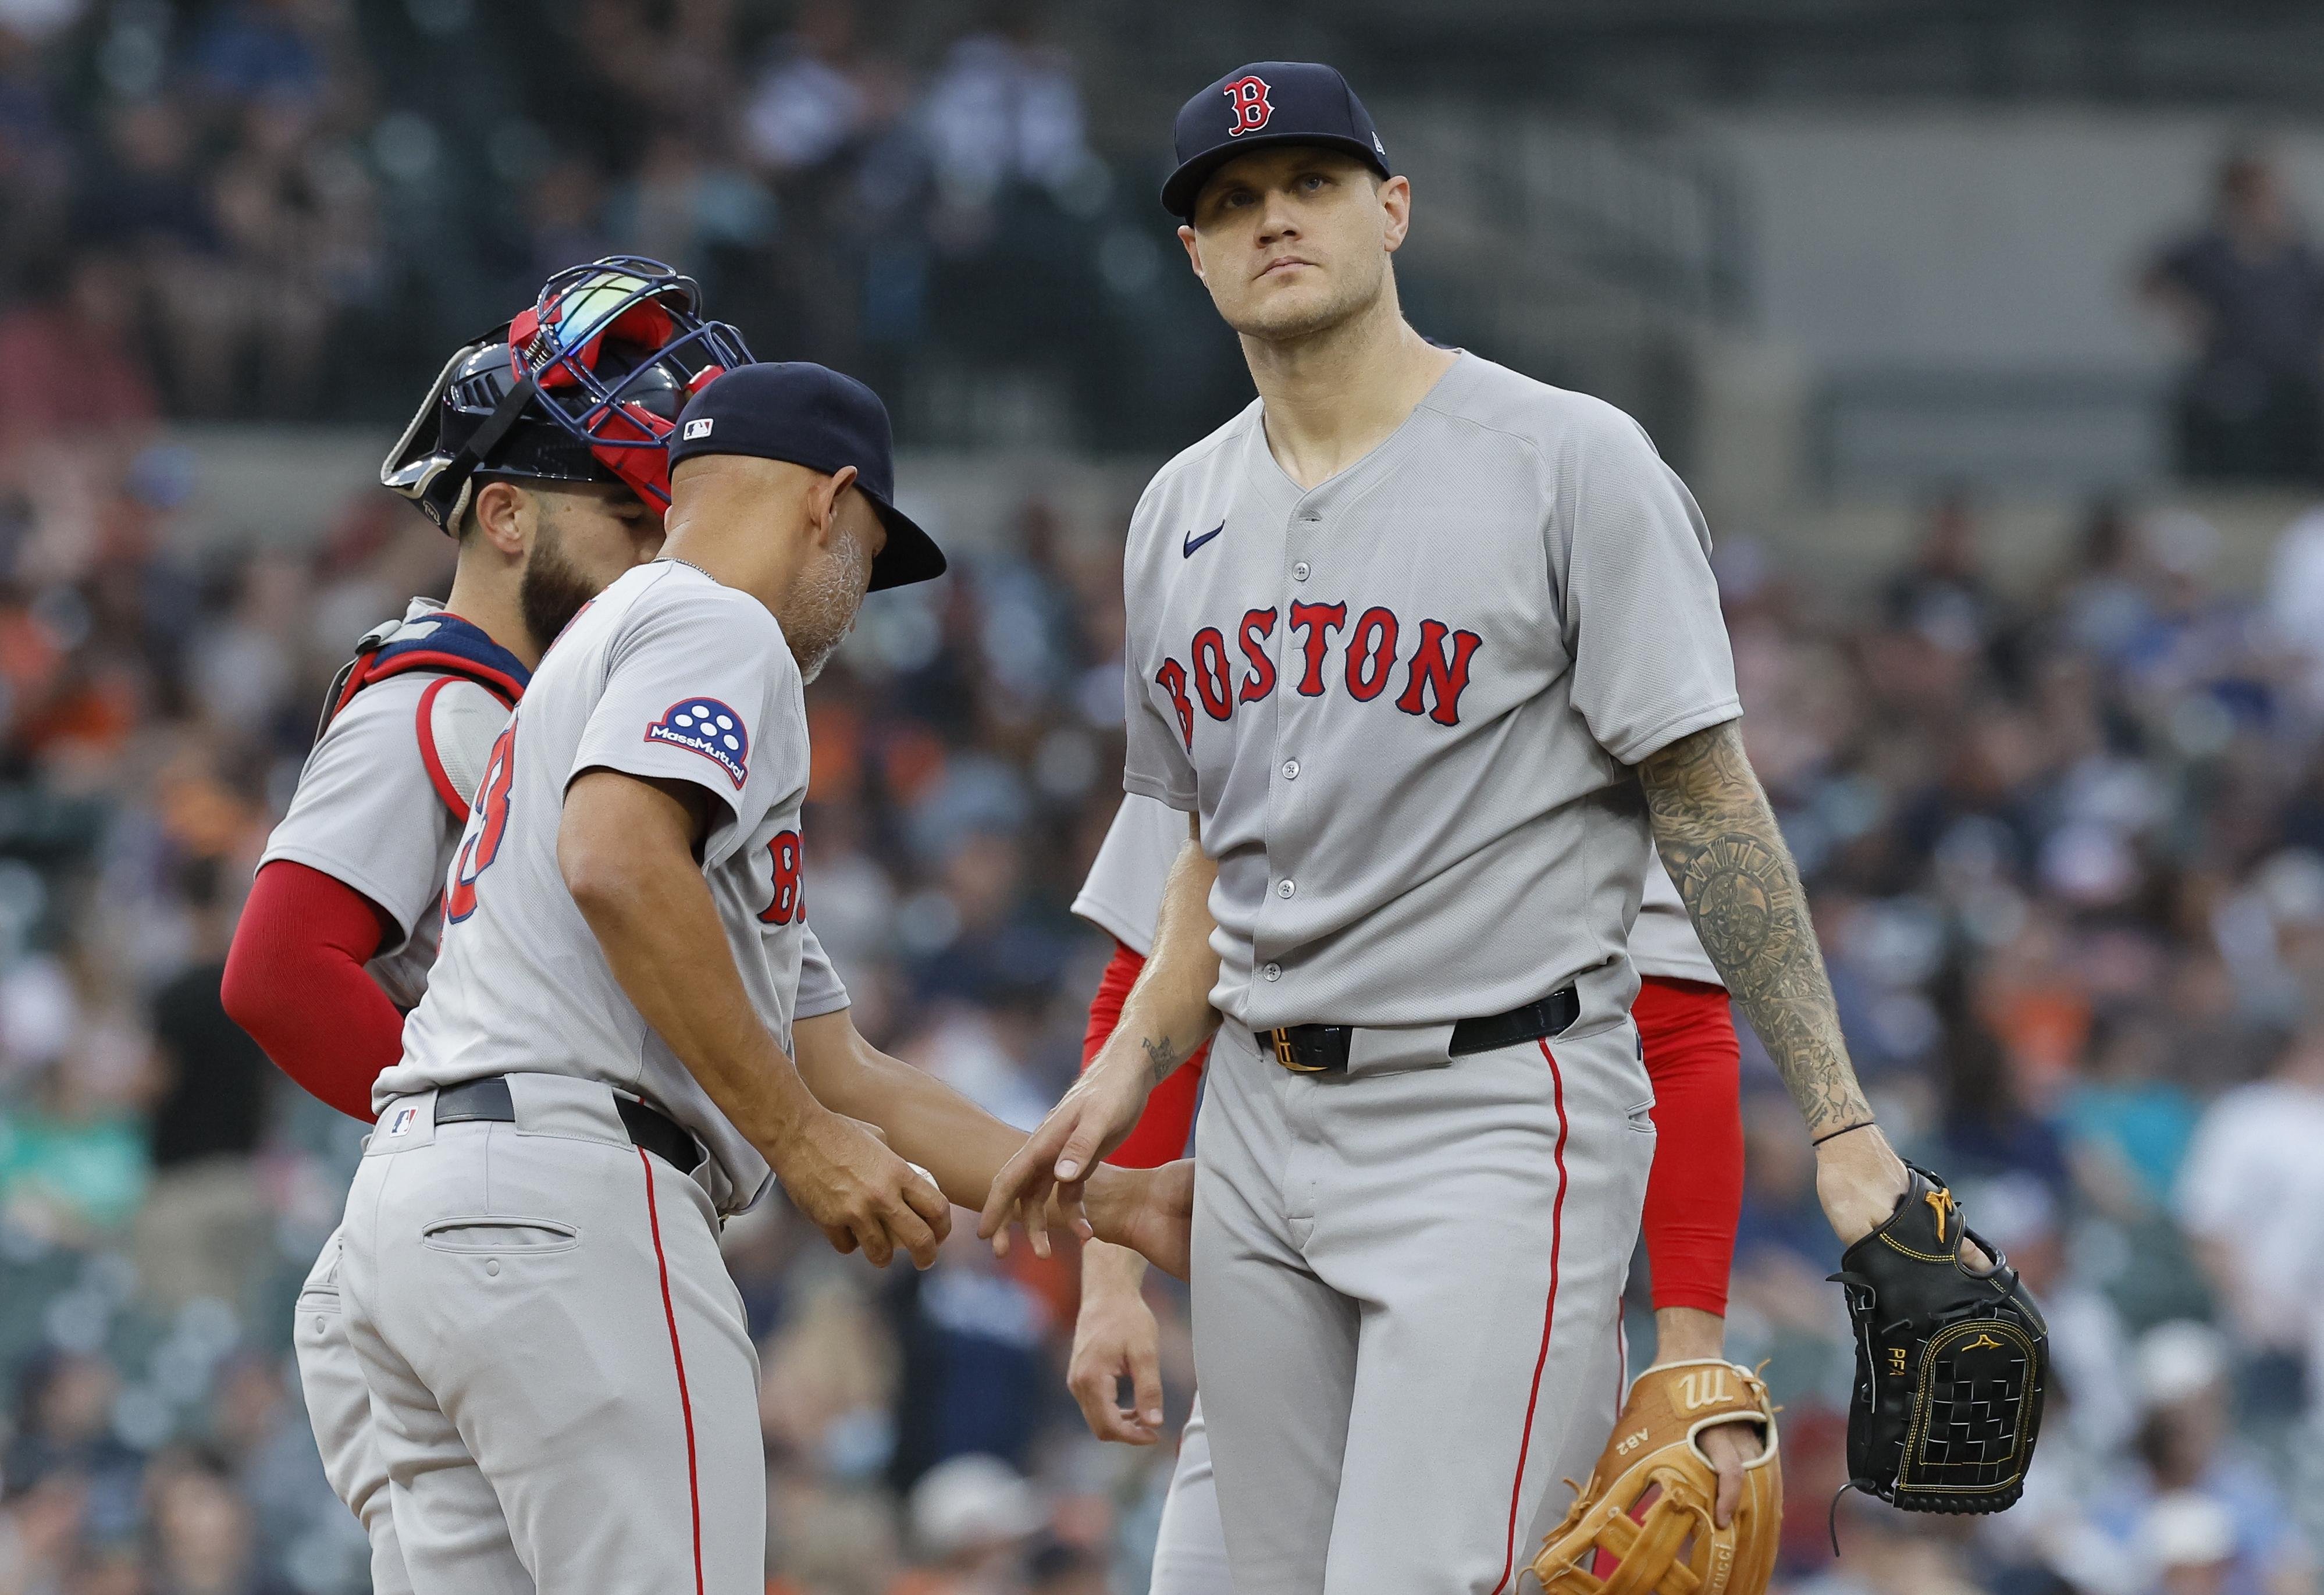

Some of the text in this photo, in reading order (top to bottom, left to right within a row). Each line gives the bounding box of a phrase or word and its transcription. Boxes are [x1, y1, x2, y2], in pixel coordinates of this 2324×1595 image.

[1224, 75, 1275, 137] B
[1155, 599, 1483, 755] BOSTON
[650, 726, 745, 781] MassMutual
[756, 829, 806, 925] B
[1888, 1348, 1906, 1376] PFA
[1615, 1427, 1649, 1455] AB2
